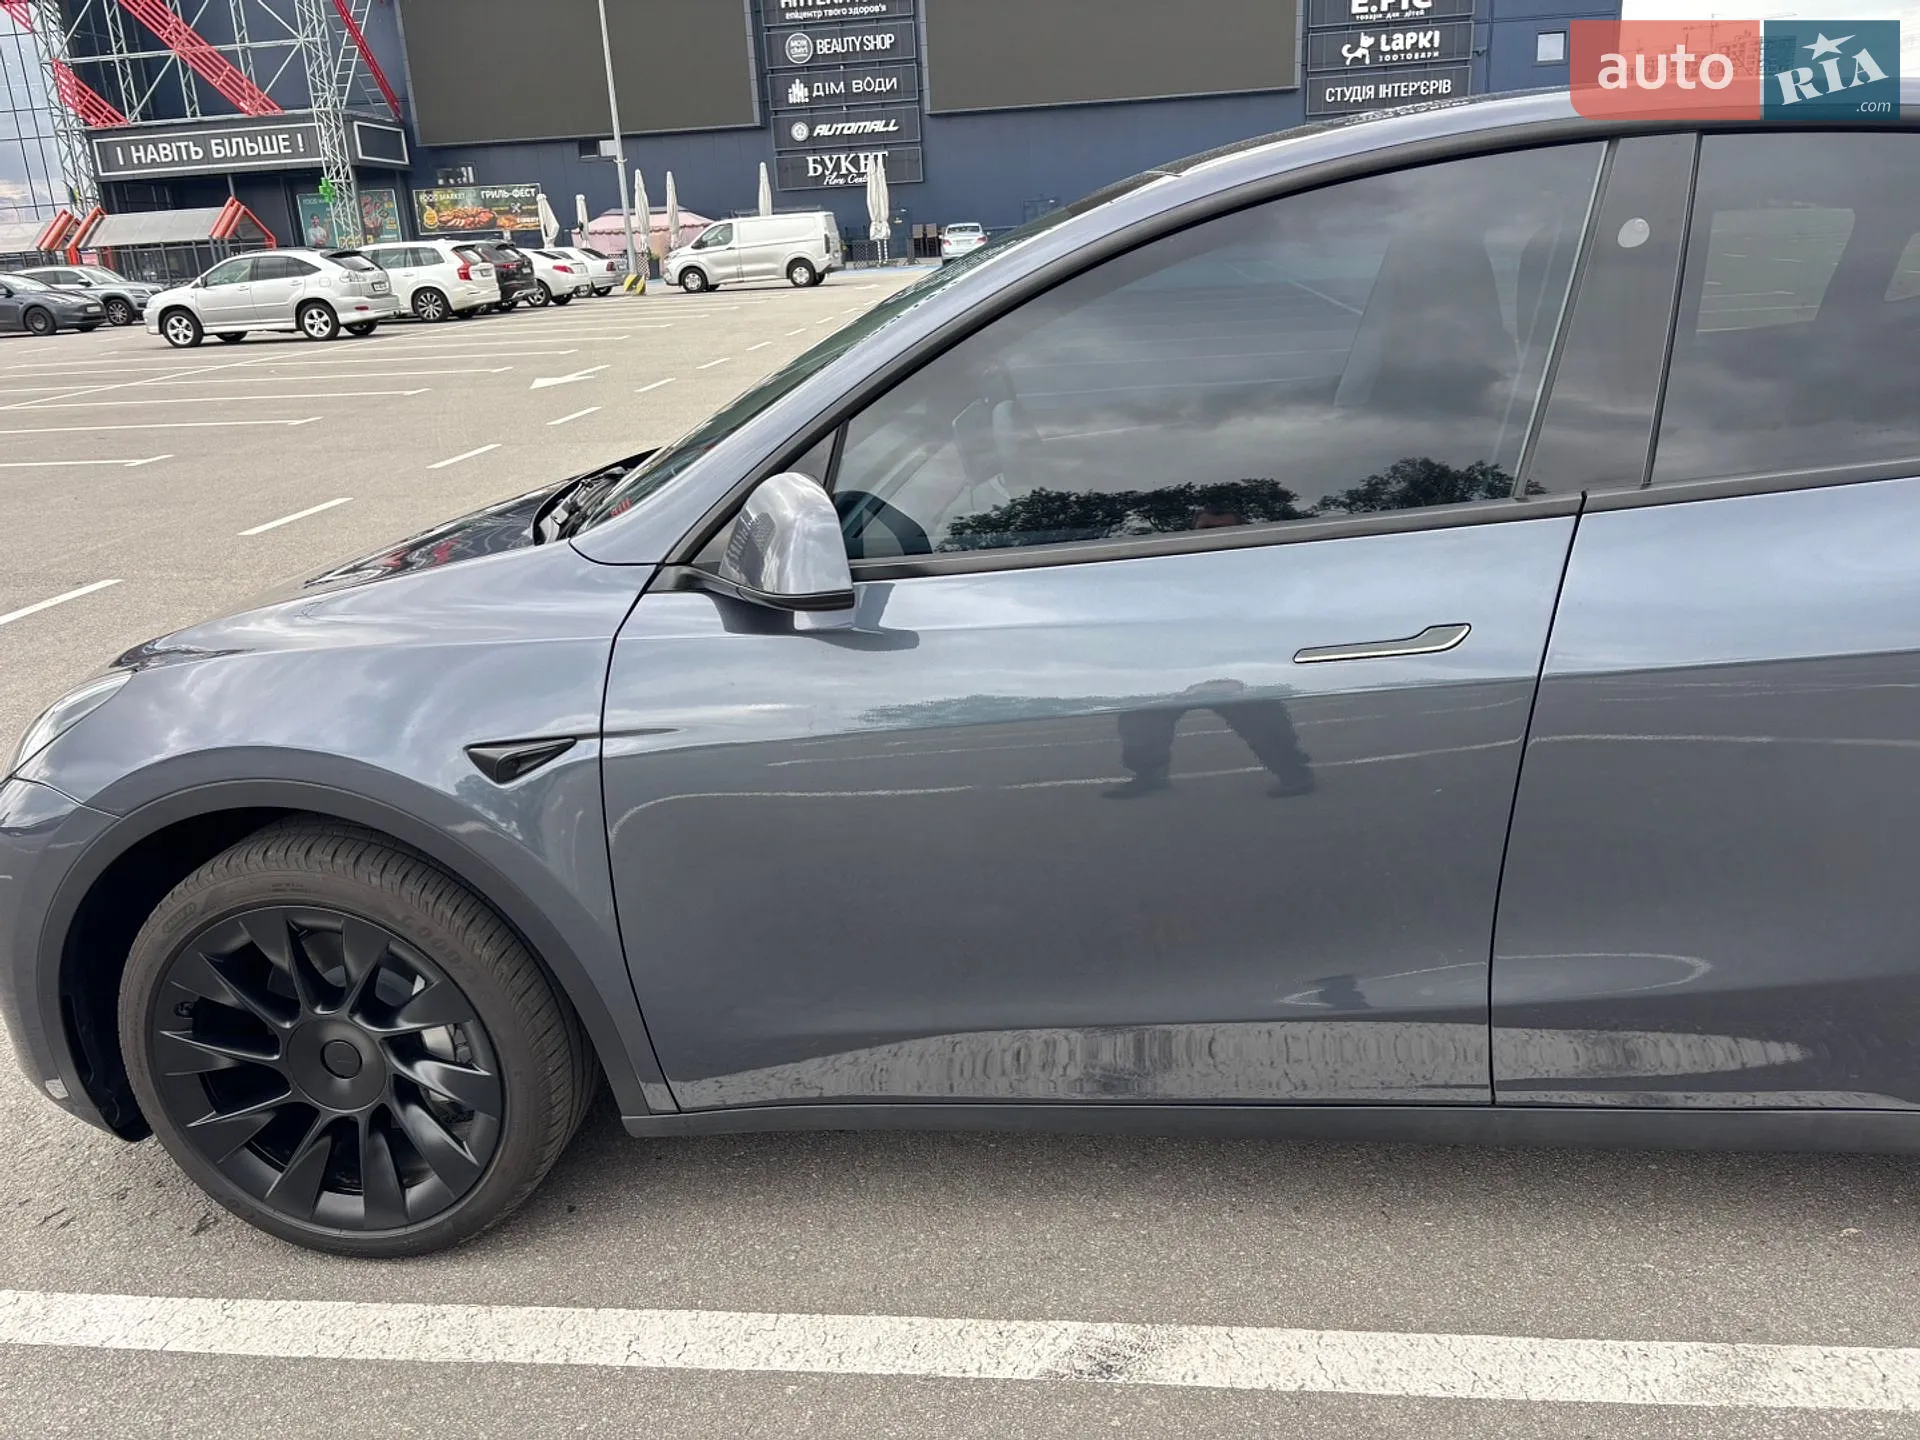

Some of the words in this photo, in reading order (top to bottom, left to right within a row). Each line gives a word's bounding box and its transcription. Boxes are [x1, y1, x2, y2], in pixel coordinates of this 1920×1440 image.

[823, 7, 847, 16] твого
[816, 36, 862, 54] BEAUTY
[863, 33, 895, 51] SHOP
[812, 81, 845, 98] ДІМ
[852, 76, 898, 93] ВОДИ
[1325, 85, 1375, 103] СТУДІЯ
[1379, 79, 1452, 99] ІНТЕР'ЄРІВ
[813, 119, 900, 137] AUTOMALL
[130, 140, 204, 165] НАВІТЬ
[210, 134, 292, 159] БІЛЬШЕ
[480, 188, 536, 200] ГРИЛЬ-ФЕСТ
